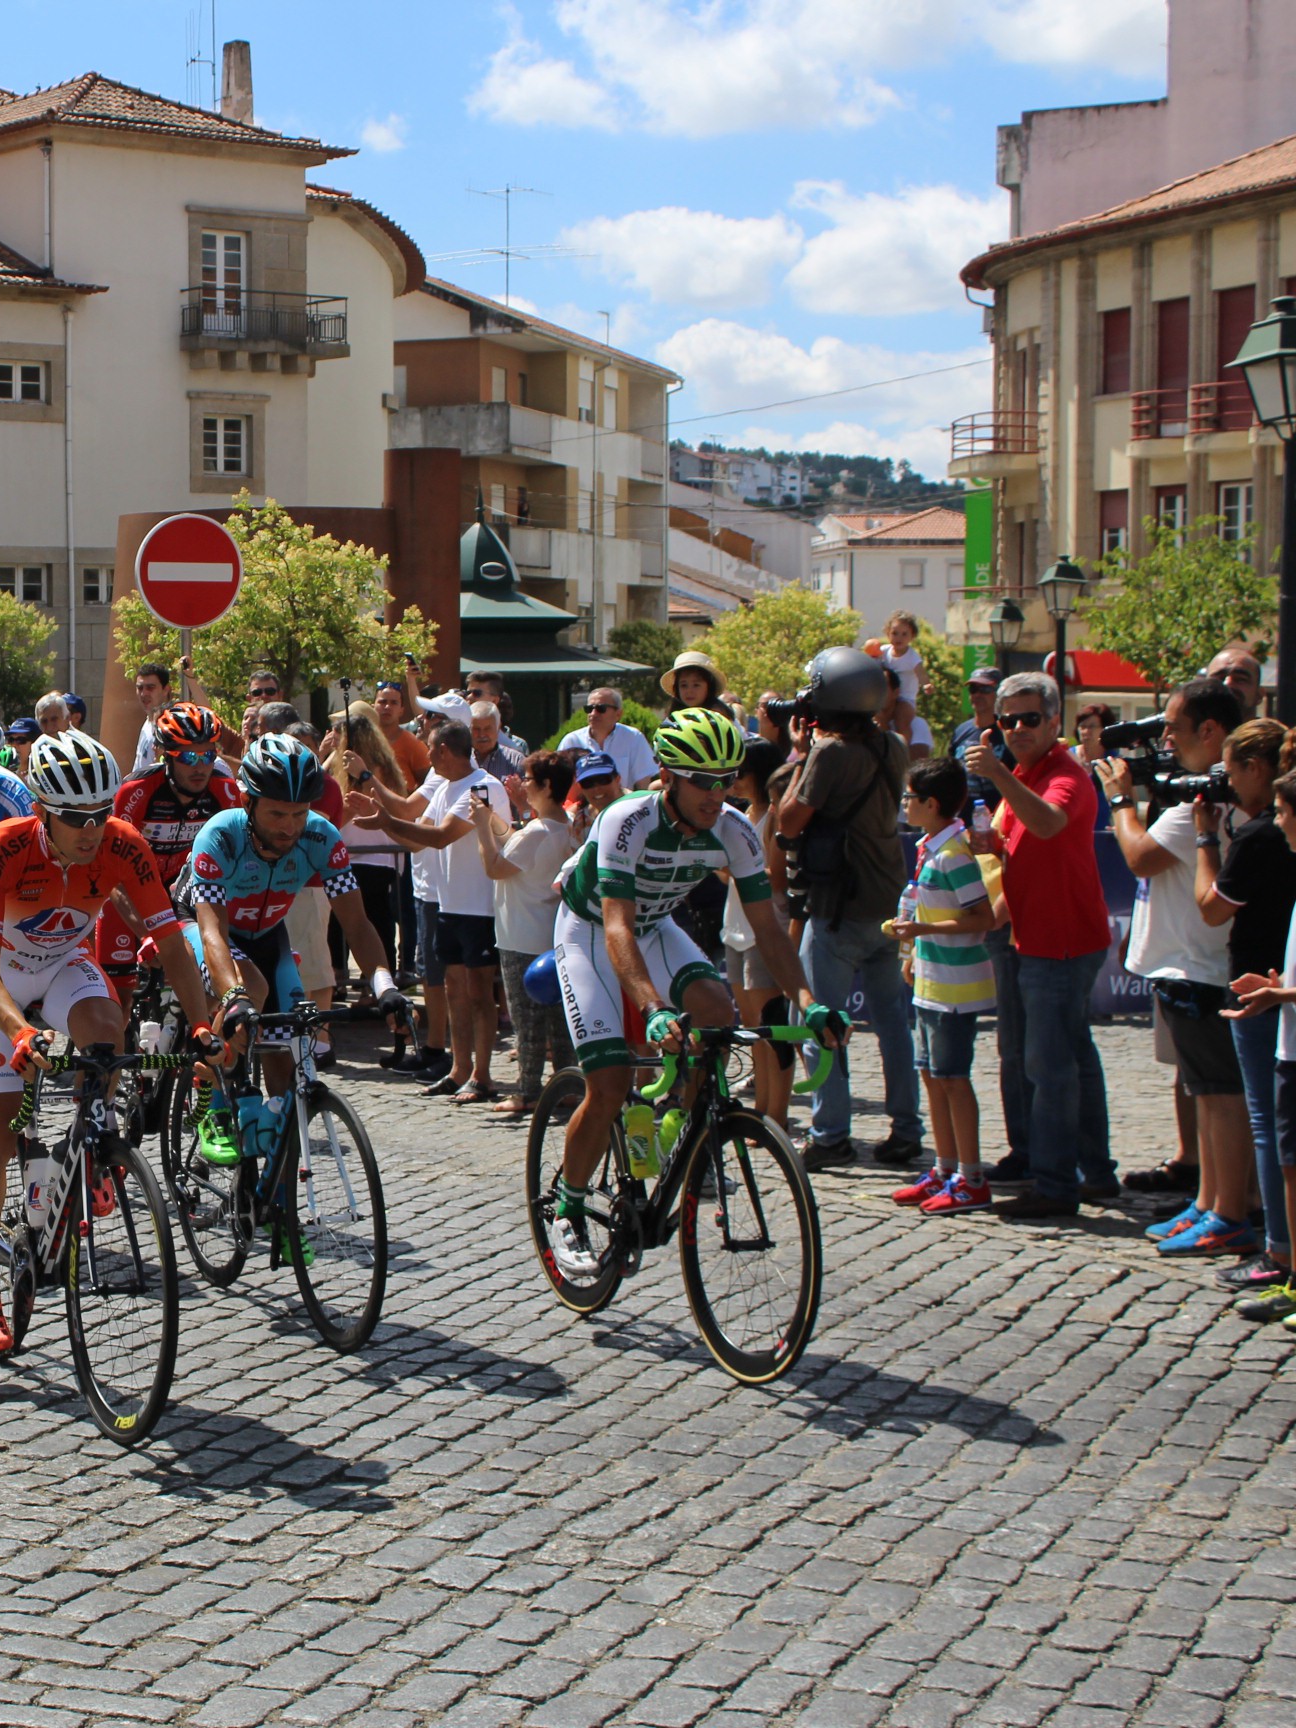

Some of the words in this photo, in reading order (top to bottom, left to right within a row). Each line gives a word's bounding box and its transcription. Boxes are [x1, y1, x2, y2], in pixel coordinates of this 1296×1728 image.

[124, 788, 144, 813] PACTO
[615, 806, 651, 854] SPORTING
[110, 837, 155, 887] BIFASE
[199, 861, 219, 873] RP
[333, 848, 347, 864] RP
[234, 903, 287, 921] RP
[560, 965, 588, 1041] SPORTING
